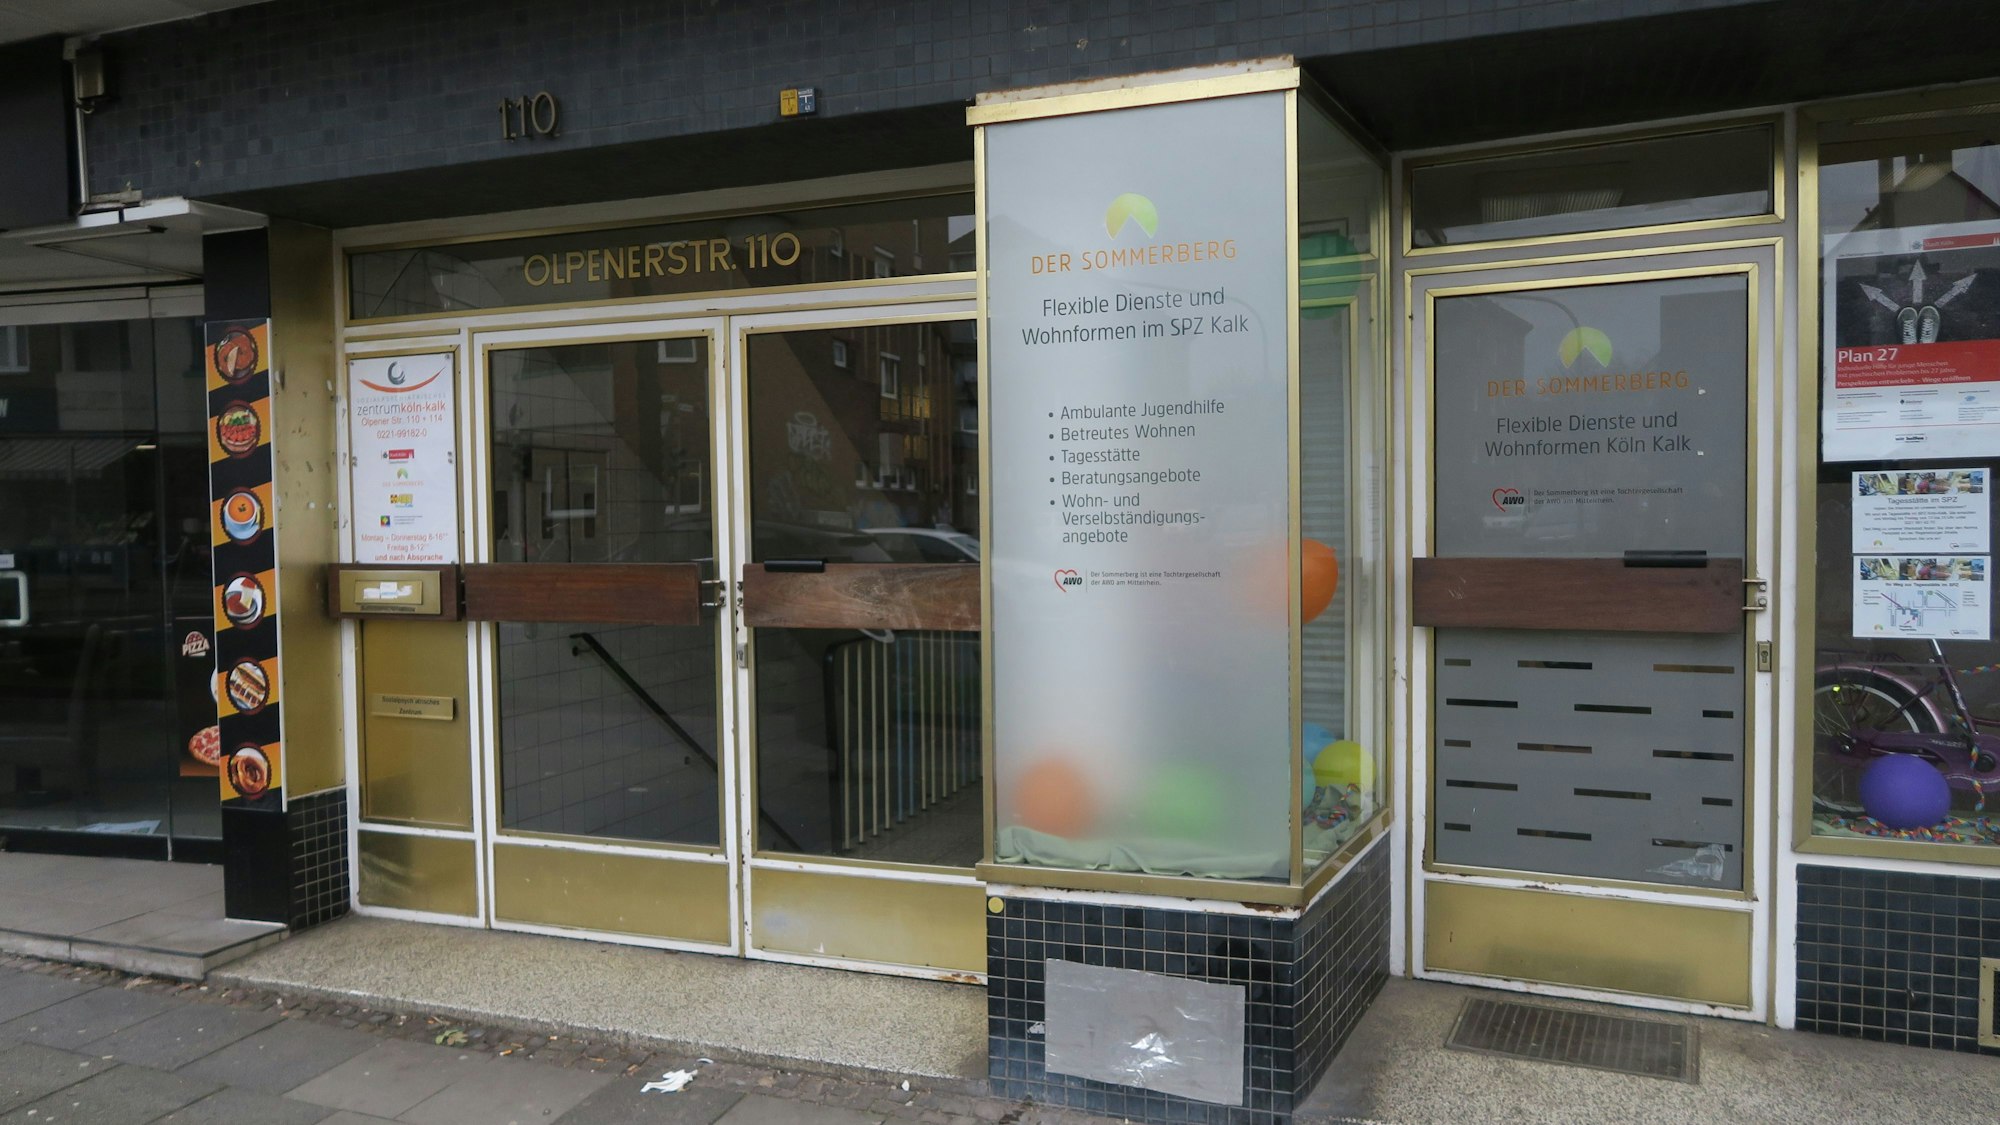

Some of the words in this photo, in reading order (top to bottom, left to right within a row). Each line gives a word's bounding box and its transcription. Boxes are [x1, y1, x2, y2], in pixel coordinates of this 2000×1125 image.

[498, 91, 556, 139] 110
[524, 238, 737, 286] OLPENERSTR.
[745, 231, 801, 269] 110
[1031, 253, 1072, 274] DER
[1081, 239, 1237, 270] SOMMERBERG
[1043, 296, 1109, 317] Flexible
[1116, 291, 1182, 312] Dienste
[1189, 286, 1225, 306] und
[1022, 322, 1136, 346] Wohnformen
[1142, 320, 1164, 338] im
[1170, 317, 1204, 336] SPZ
[1211, 314, 1249, 334] Kalk
[1838, 350, 1873, 363] Plan
[1877, 348, 1899, 361] 27
[1487, 380, 1526, 398] DER
[1537, 371, 1689, 395] SOMMERBERG
[357, 400, 446, 416] zentrumköln-kalk
[1060, 404, 1136, 420] Ambulante
[1141, 399, 1225, 418] Jugendhilfe
[361, 417, 389, 427] Olpener
[407, 415, 420, 424] 110
[429, 414, 443, 423] 114
[1497, 415, 1562, 434] Flexible
[1569, 412, 1636, 431] Dienste
[1643, 411, 1678, 429] und
[1061, 426, 1129, 441] Betreutes
[1135, 424, 1195, 439] Wohnen
[1485, 437, 1600, 457] Wohnformen
[1607, 436, 1645, 454] Köln
[1653, 434, 1691, 452] Kalk
[1061, 448, 1140, 465] Tagesstätte
[1061, 470, 1201, 487] Beratungsangebote
[1062, 494, 1109, 507] Wohn-
[1113, 492, 1140, 507] und
[1502, 496, 1524, 505] AWO
[1546, 489, 1589, 497] Sommerberg
[1062, 510, 1206, 528] Verselbständigungs-
[361, 534, 384, 542] Montag
[390, 533, 427, 541] Donnerstag
[1062, 529, 1128, 545] angebote
[387, 544, 408, 552] Freitag
[407, 553, 443, 562] Absprache
[1062, 577, 1083, 585] AWO
[1101, 571, 1139, 579] Sommerberg
[182, 638, 210, 656] PIZZA
